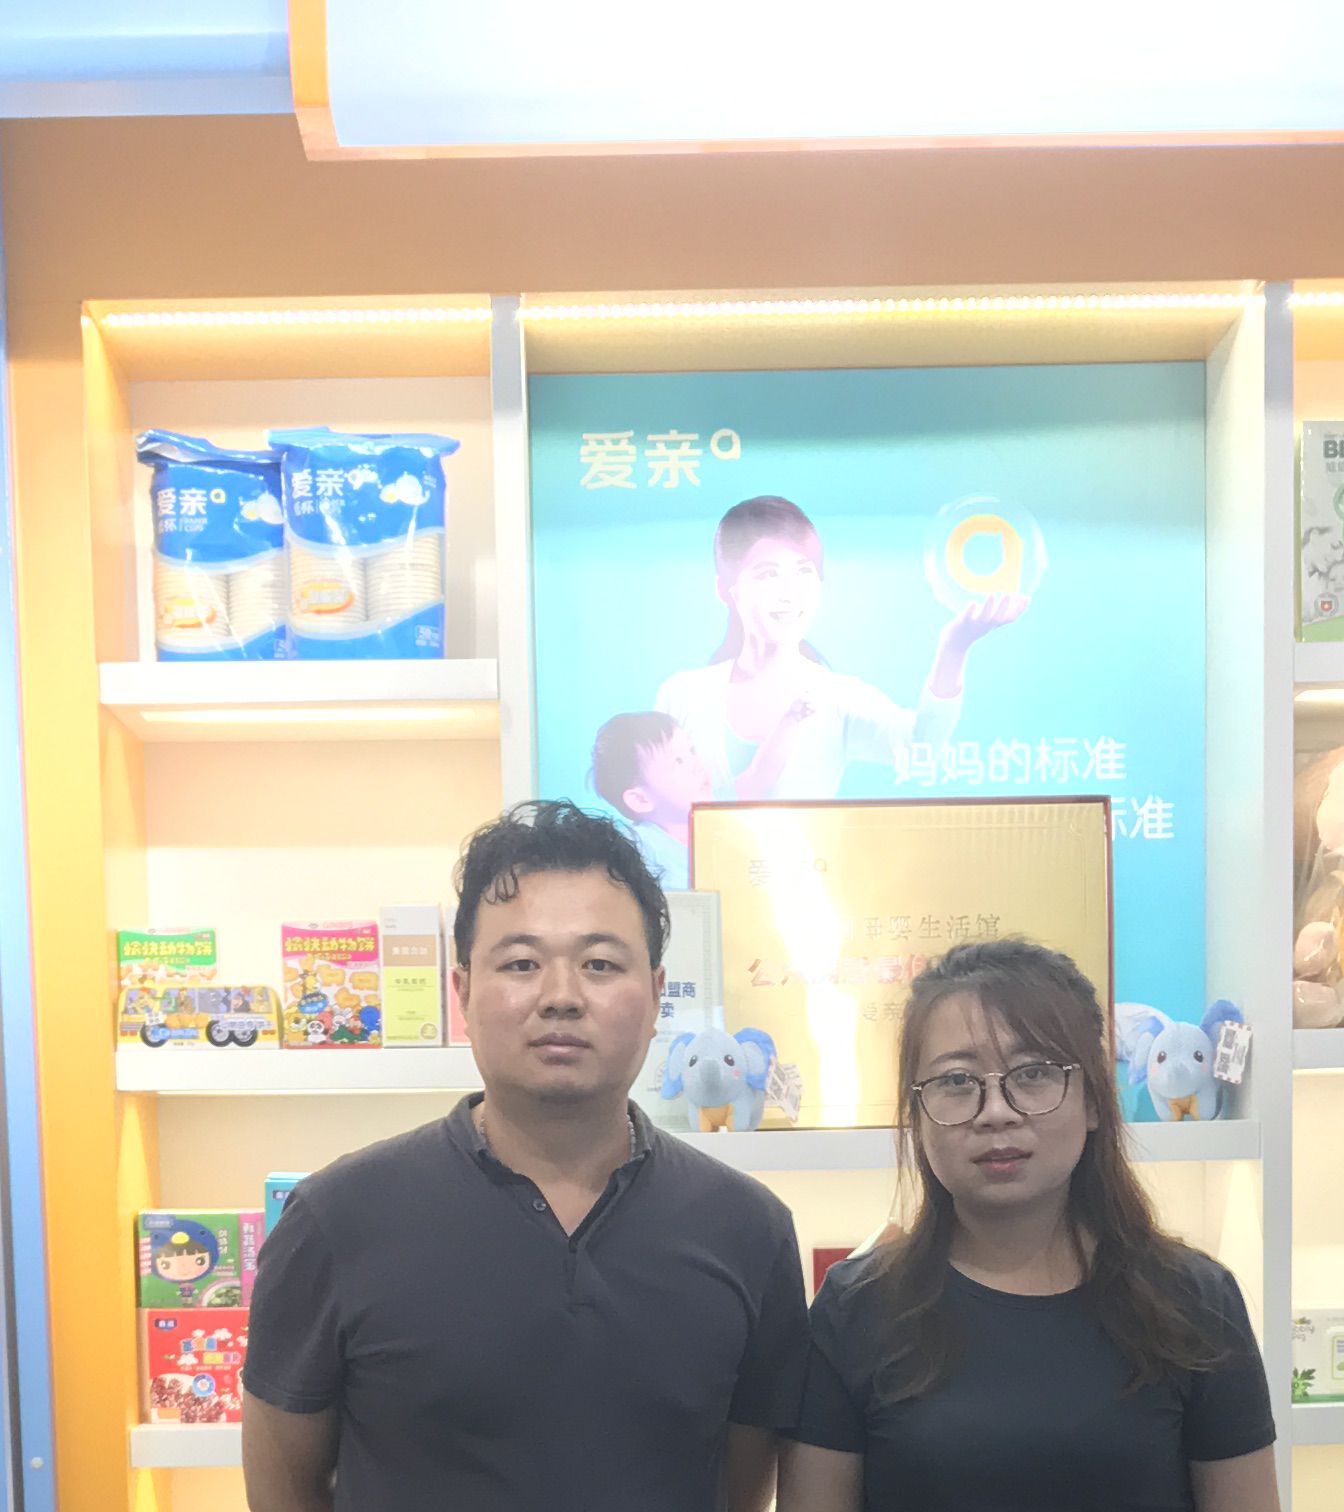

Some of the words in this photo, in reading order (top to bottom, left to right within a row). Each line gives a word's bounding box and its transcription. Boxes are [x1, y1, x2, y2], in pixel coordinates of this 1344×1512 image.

[579, 429, 703, 490] 爱亲
[157, 487, 208, 516] 爱亲
[291, 467, 344, 499] 爱亲
[894, 736, 1127, 787] 妈妈的标准
